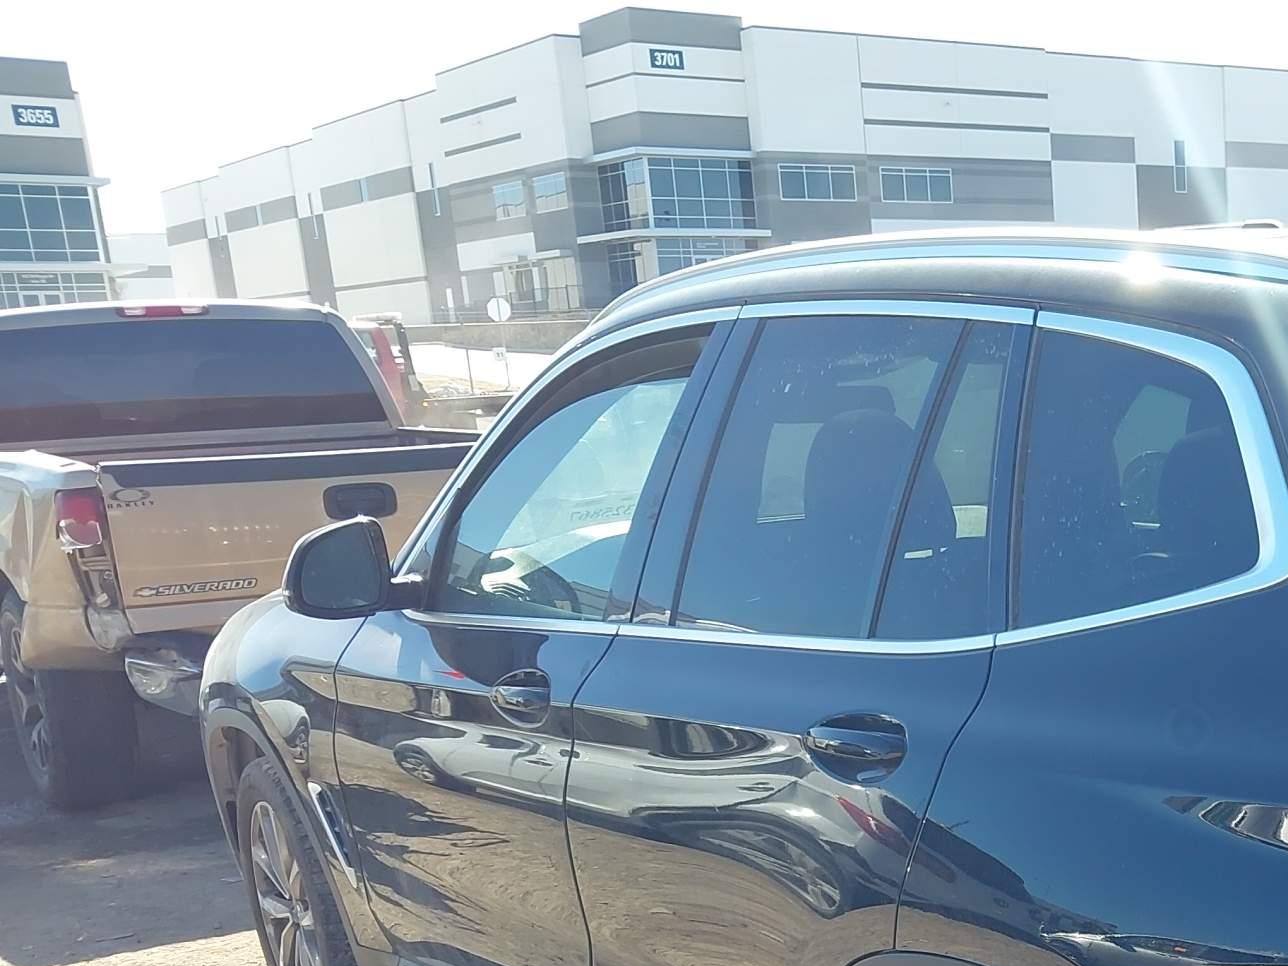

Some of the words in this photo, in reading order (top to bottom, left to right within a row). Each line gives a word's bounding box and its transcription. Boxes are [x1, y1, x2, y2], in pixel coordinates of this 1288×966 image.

[654, 52, 680, 66] 3701
[17, 108, 54, 124] 3655
[155, 578, 257, 596] SILVERADO
